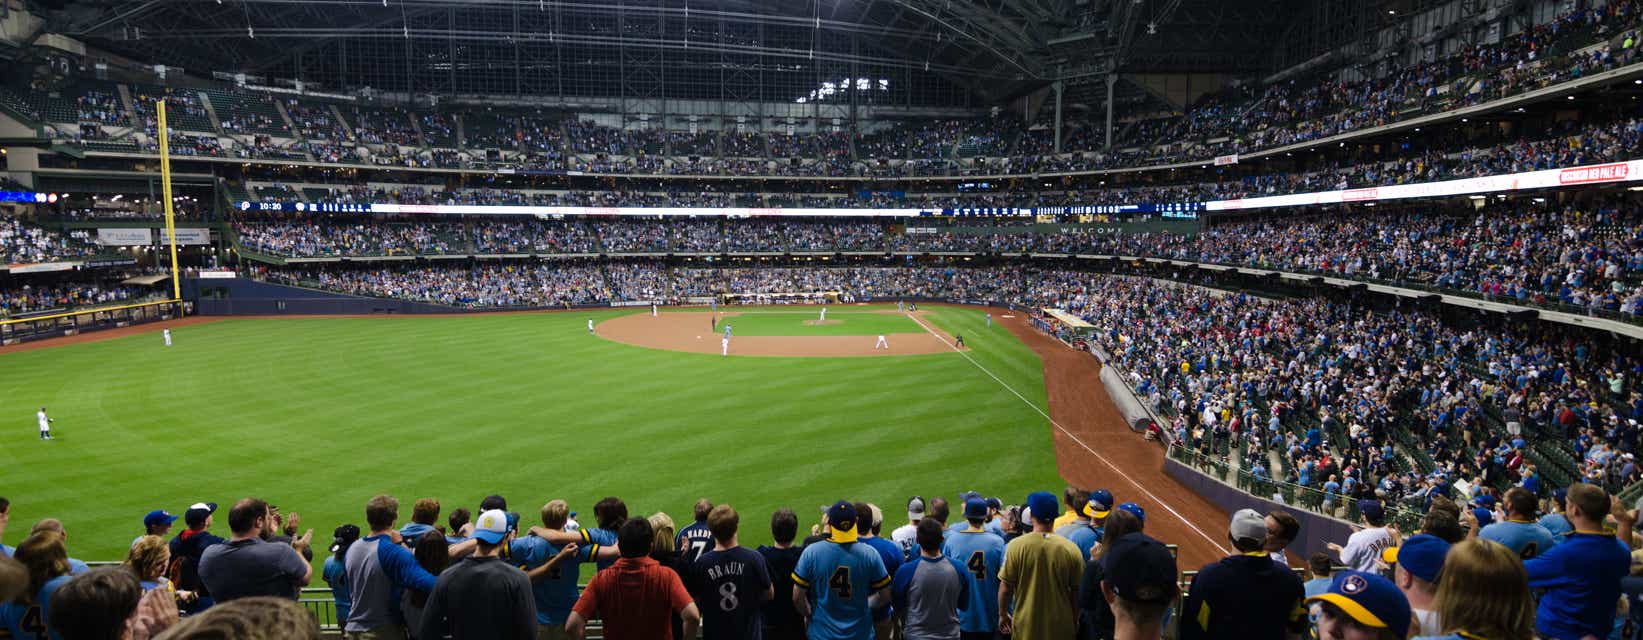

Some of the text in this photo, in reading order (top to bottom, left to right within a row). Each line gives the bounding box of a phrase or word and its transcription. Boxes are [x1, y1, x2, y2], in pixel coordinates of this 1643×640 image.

[1615, 165, 1627, 177] ALE
[259, 202, 282, 210] 10:20
[687, 528, 712, 539] HARDY
[691, 541, 707, 562] 7
[707, 561, 745, 580] BRAUN
[967, 550, 986, 580] 4
[829, 565, 851, 599] 4
[719, 581, 738, 611] 8
